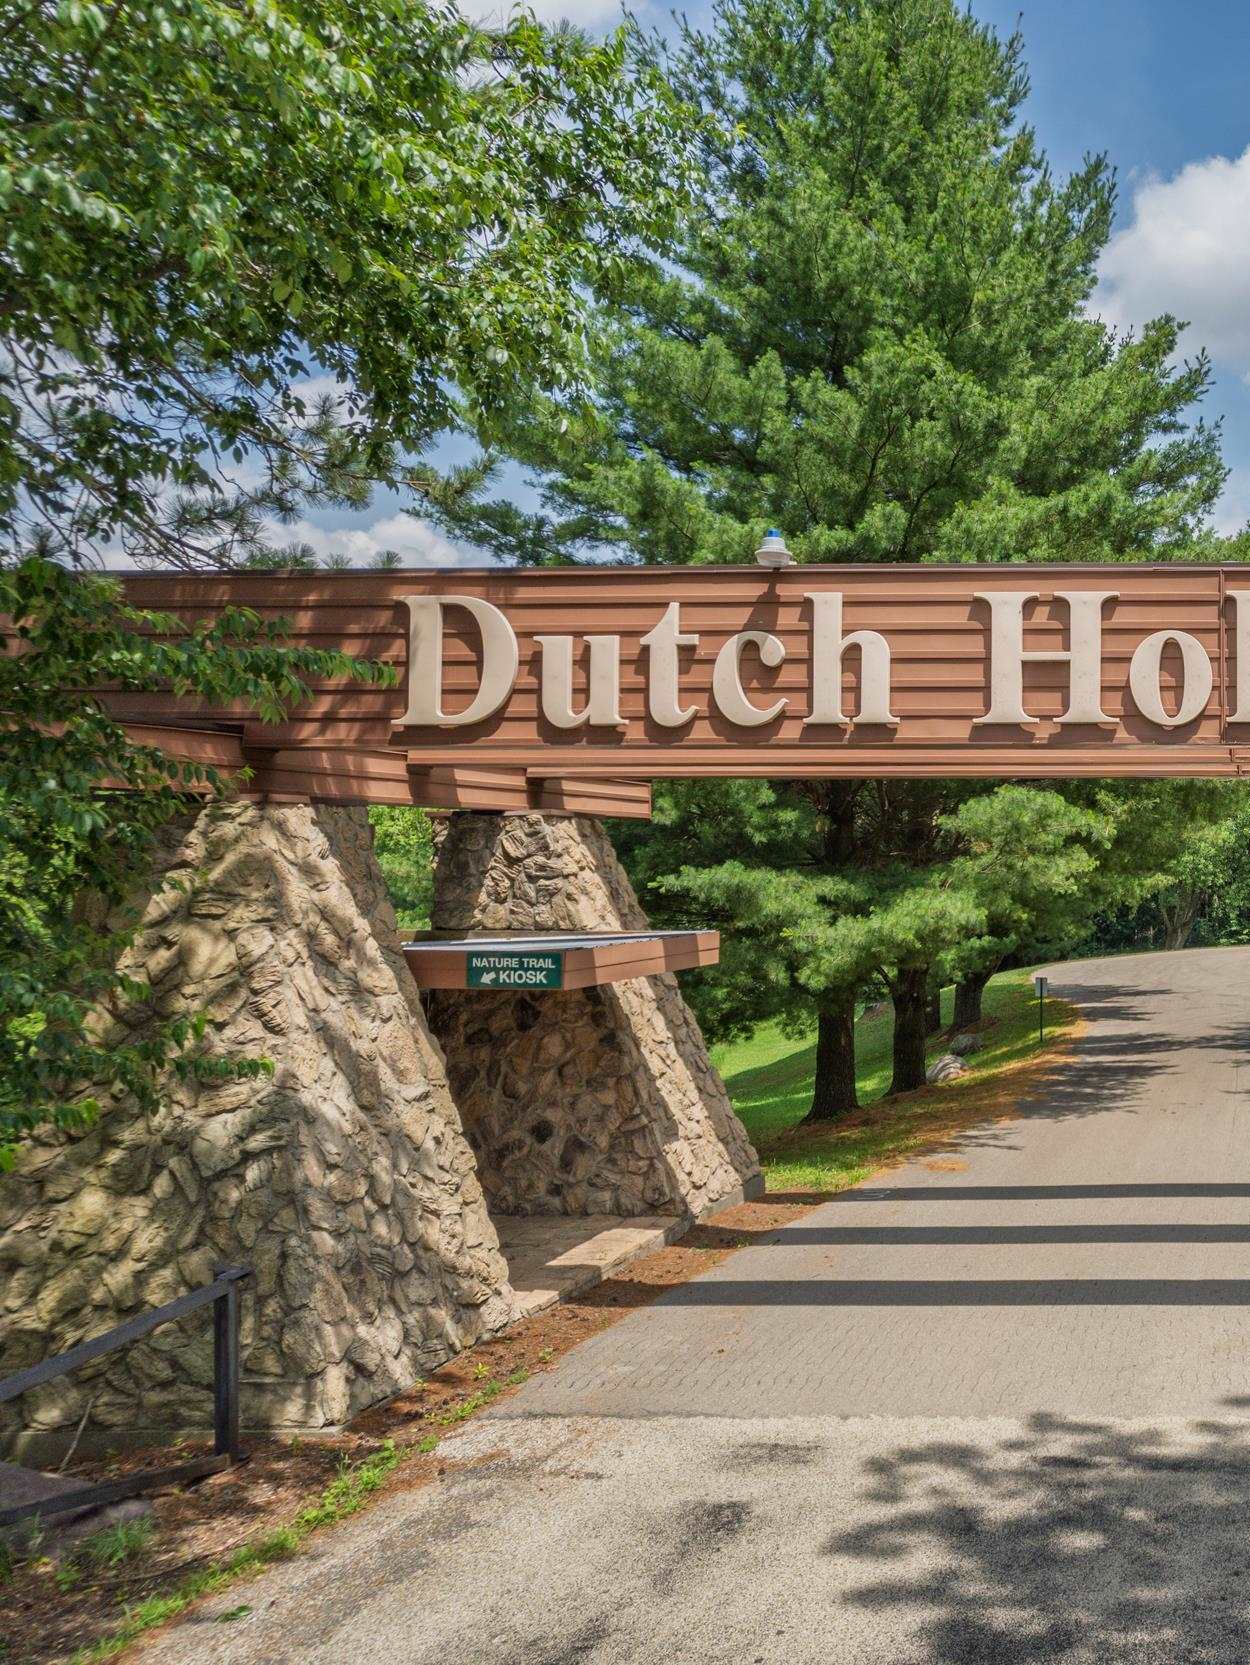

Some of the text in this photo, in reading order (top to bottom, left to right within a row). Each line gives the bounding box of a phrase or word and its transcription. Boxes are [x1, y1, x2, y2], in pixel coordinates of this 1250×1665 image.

[391, 591, 901, 729] Dutch
[472, 957, 556, 969] NATURE TRAIL
[499, 970, 548, 984] KIOSK
